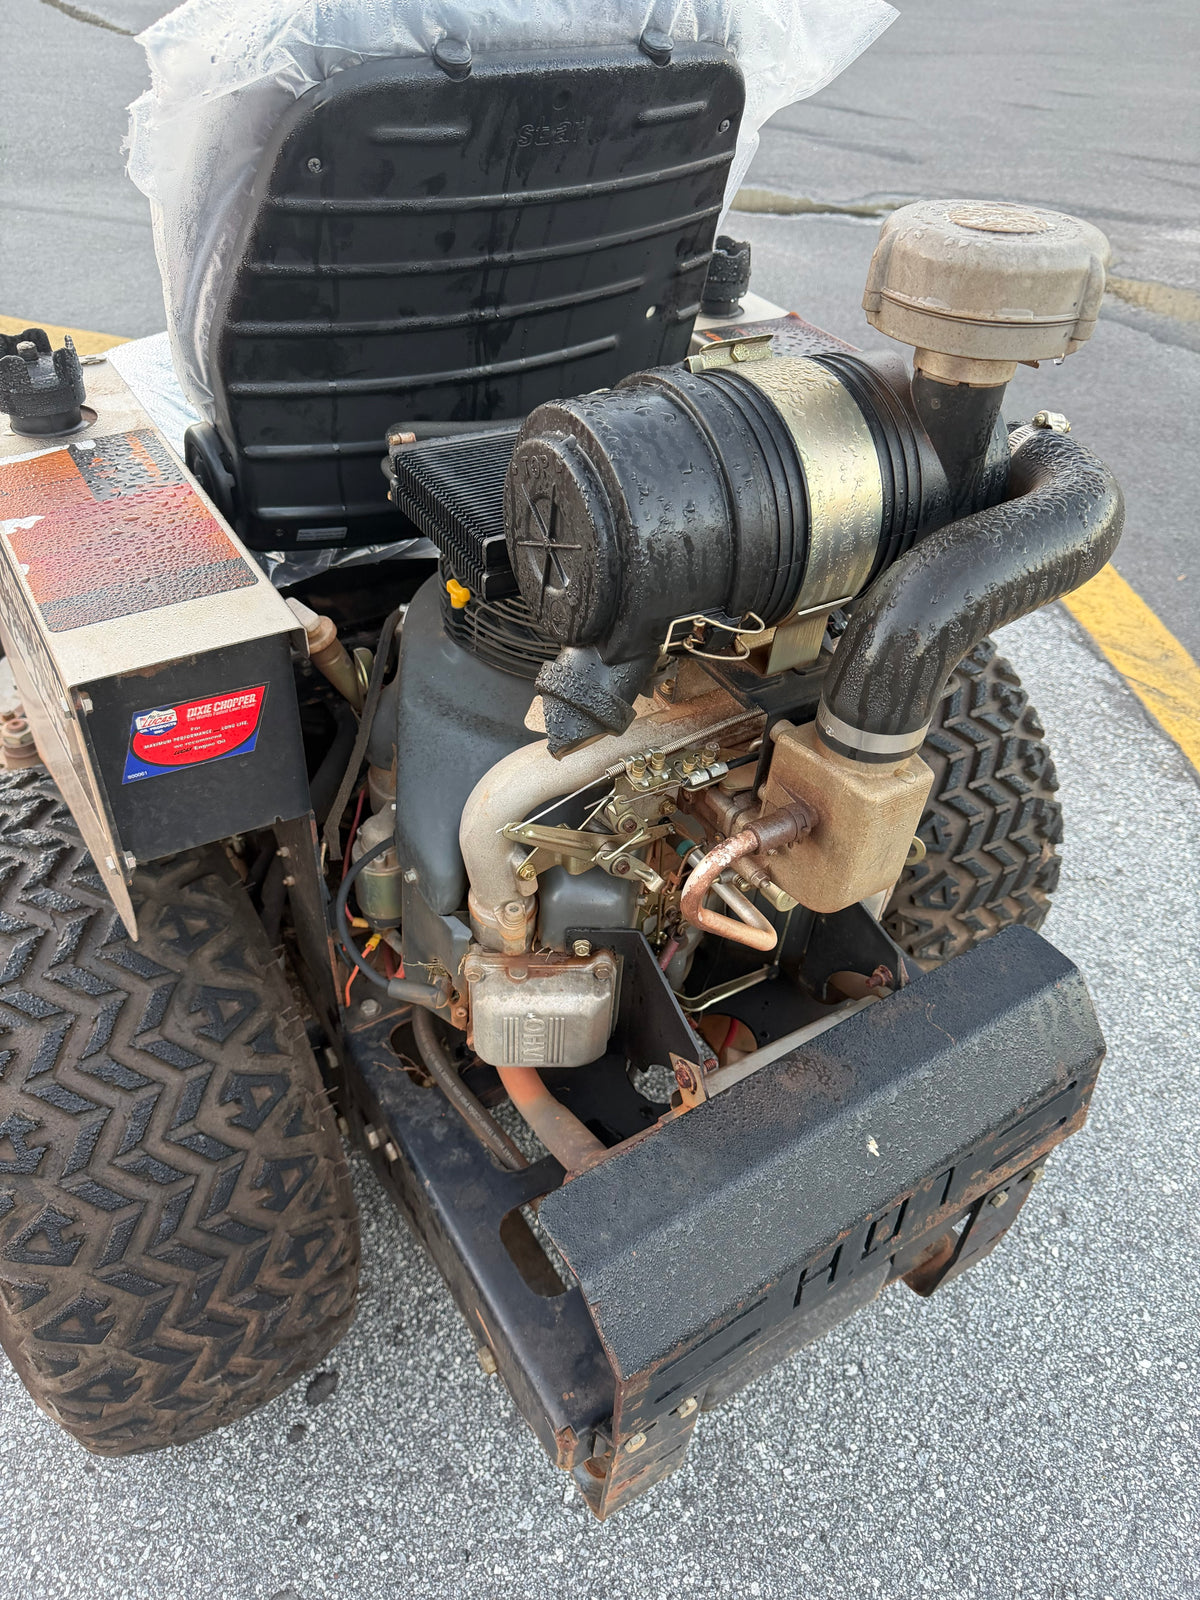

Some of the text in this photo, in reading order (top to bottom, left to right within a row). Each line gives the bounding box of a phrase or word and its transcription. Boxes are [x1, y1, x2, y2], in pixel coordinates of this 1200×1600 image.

[520, 453, 550, 479] TOP
[187, 703, 213, 718] DIXIE
[213, 693, 257, 712] CHOPPER
[144, 739, 172, 749] MAXIMUM
[173, 729, 212, 742] PERFORMANCE
[221, 722, 236, 731] LONG
[185, 733, 222, 746] recommend
[194, 740, 216, 751] Engine
